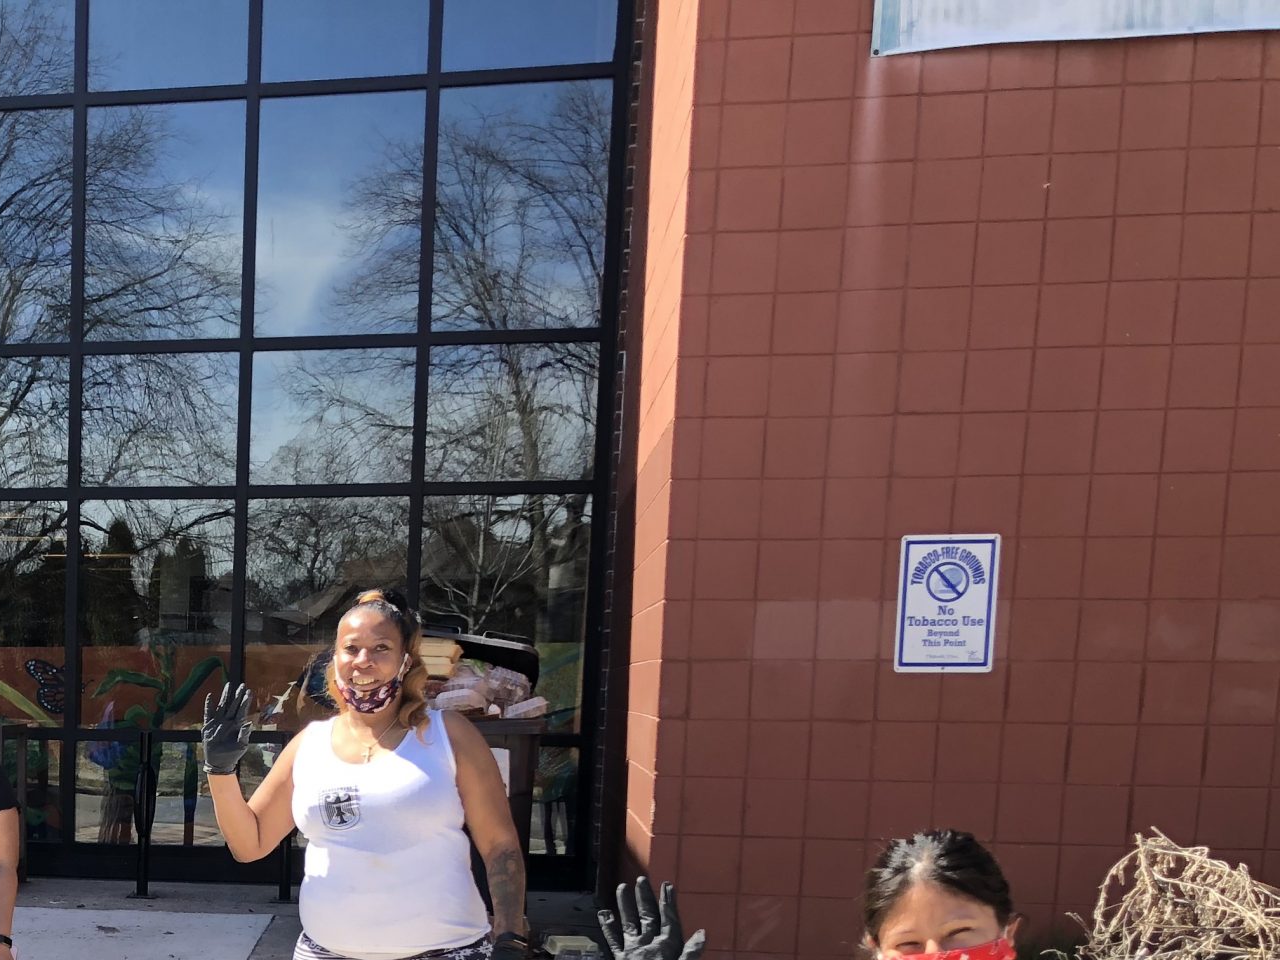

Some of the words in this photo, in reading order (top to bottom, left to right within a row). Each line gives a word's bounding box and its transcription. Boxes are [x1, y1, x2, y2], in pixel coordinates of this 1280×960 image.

[910, 546, 960, 585] TOBACCO-FREE
[958, 549, 986, 585] GROUNDS
[937, 605, 955, 616] No
[907, 616, 958, 627] Tobacco
[962, 616, 985, 627] Use
[927, 629, 960, 639] Beyond
[922, 639, 942, 647] This
[943, 639, 968, 647] Point
